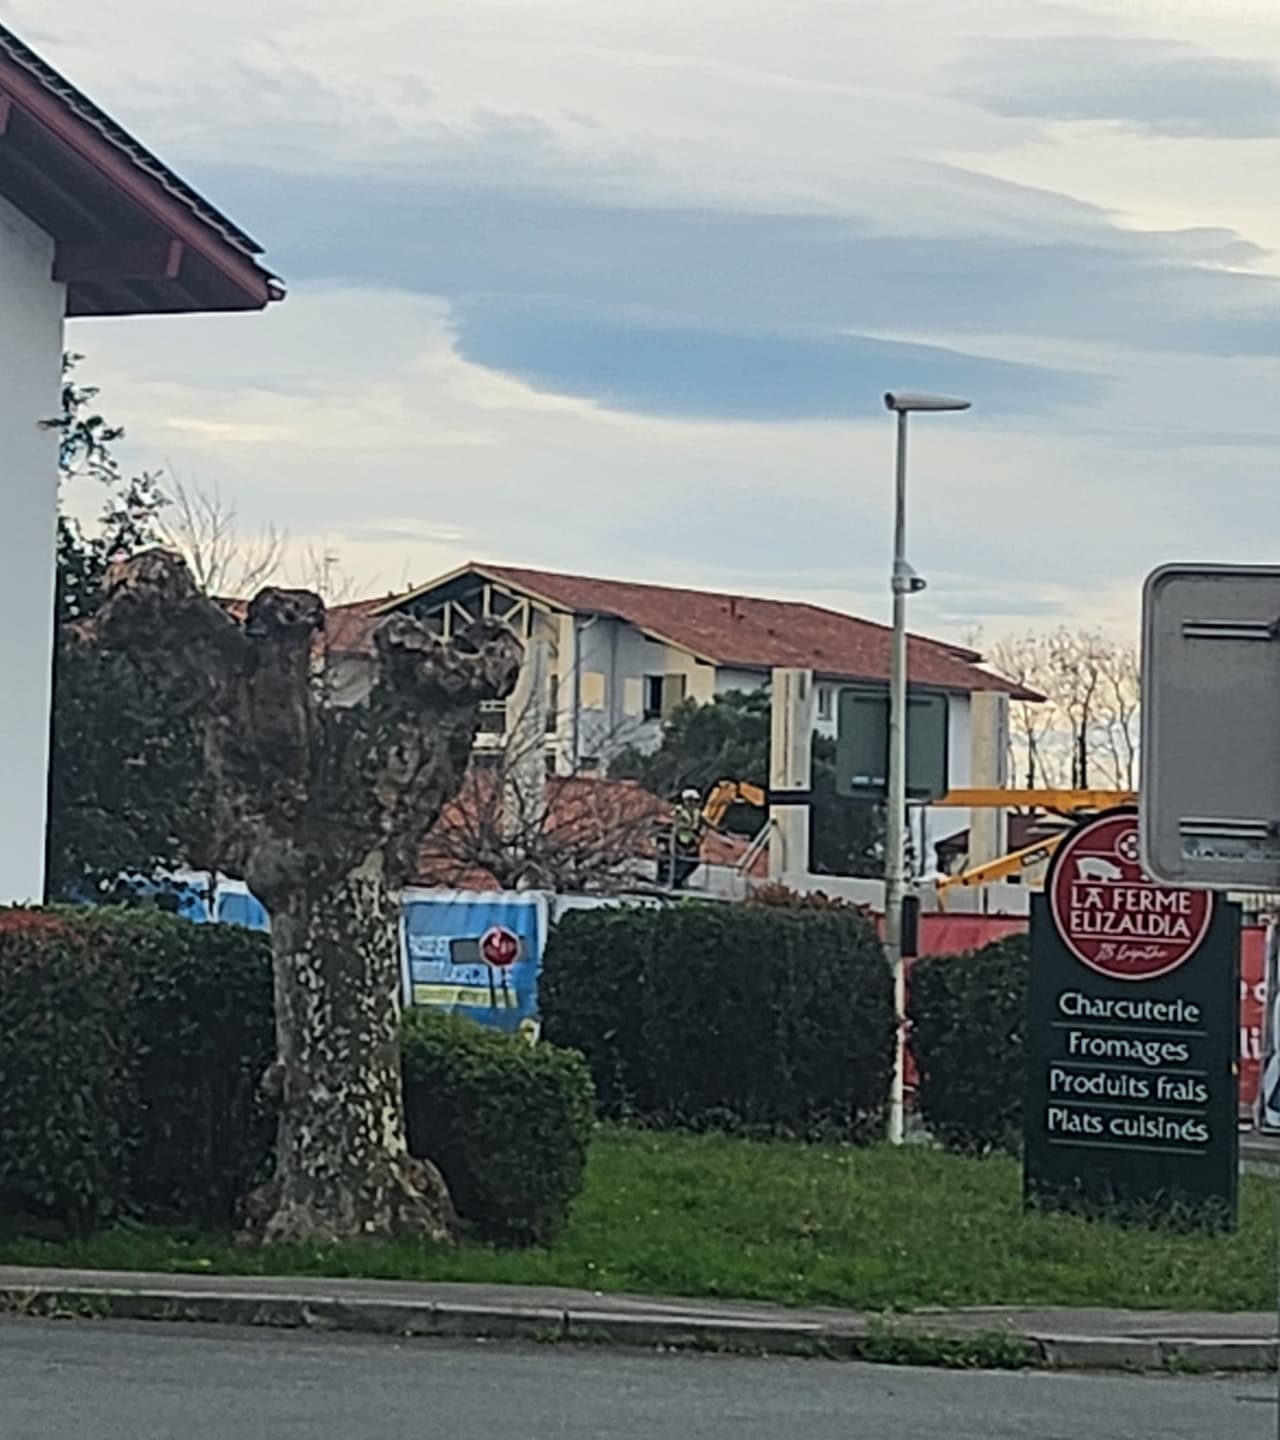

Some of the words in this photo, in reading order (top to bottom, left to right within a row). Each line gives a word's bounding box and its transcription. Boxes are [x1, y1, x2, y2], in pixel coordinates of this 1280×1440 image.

[1070, 886, 1104, 909] LA
[1113, 888, 1192, 914] FERME
[1070, 910, 1191, 937] ELIZALDIA
[1059, 992, 1200, 1022] Charcuterie
[1069, 1031, 1189, 1065] Fromages
[1050, 1068, 1150, 1098] Produits
[1157, 1075, 1208, 1102] frais
[1048, 1108, 1104, 1133] Plats
[1109, 1114, 1209, 1142] cuisinés
